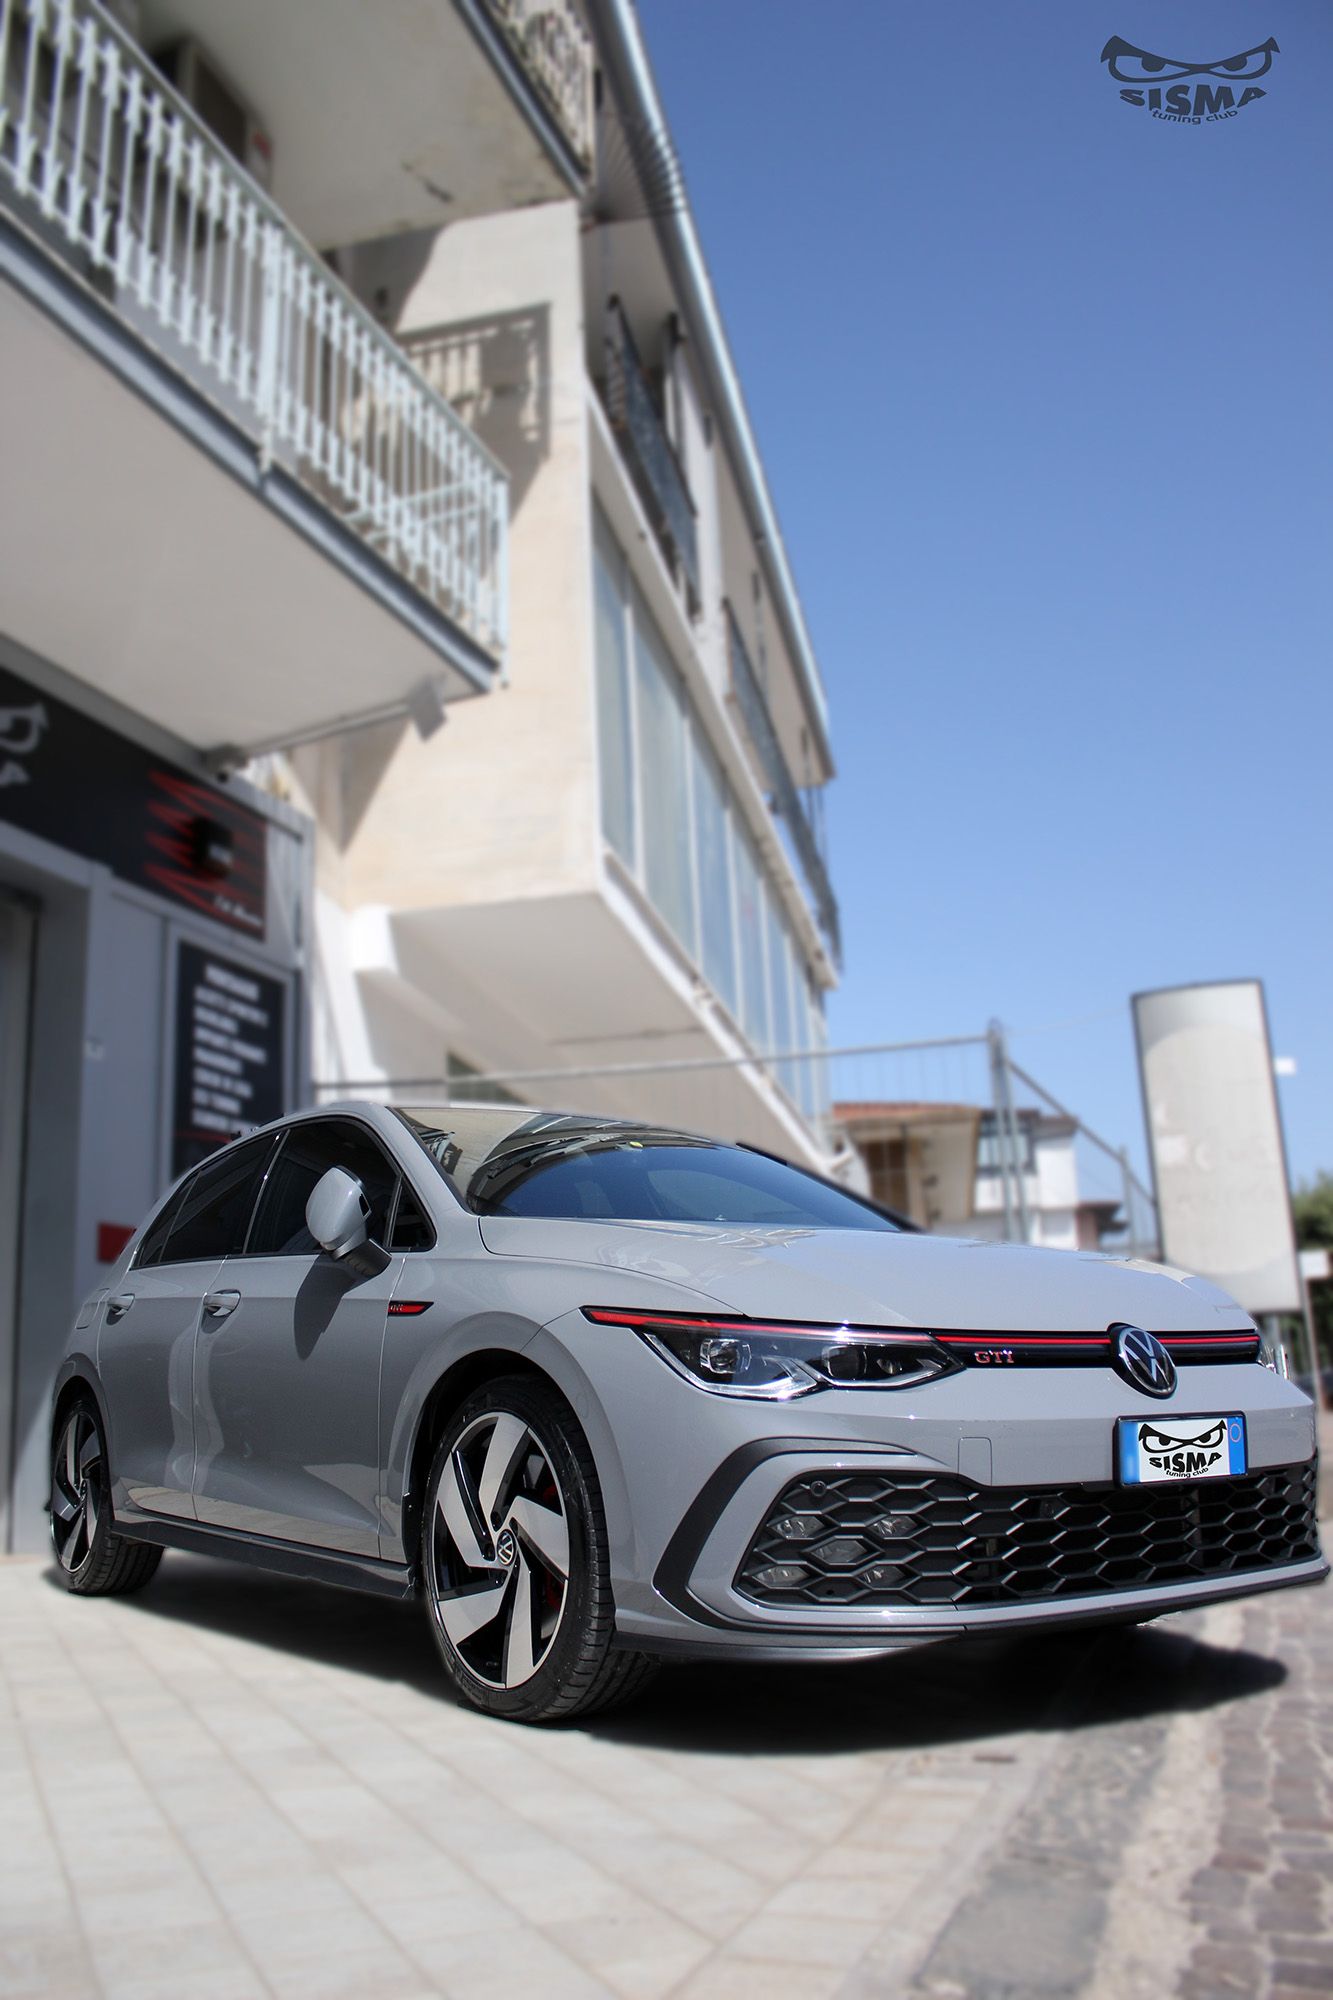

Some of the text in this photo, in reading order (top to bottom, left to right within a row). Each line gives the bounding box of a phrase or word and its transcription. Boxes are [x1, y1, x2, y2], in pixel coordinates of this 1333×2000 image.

[974, 1350, 1014, 1363] GTI
[1149, 1452, 1222, 1473] SISMA
[1166, 1467, 1209, 1478] tuning club
